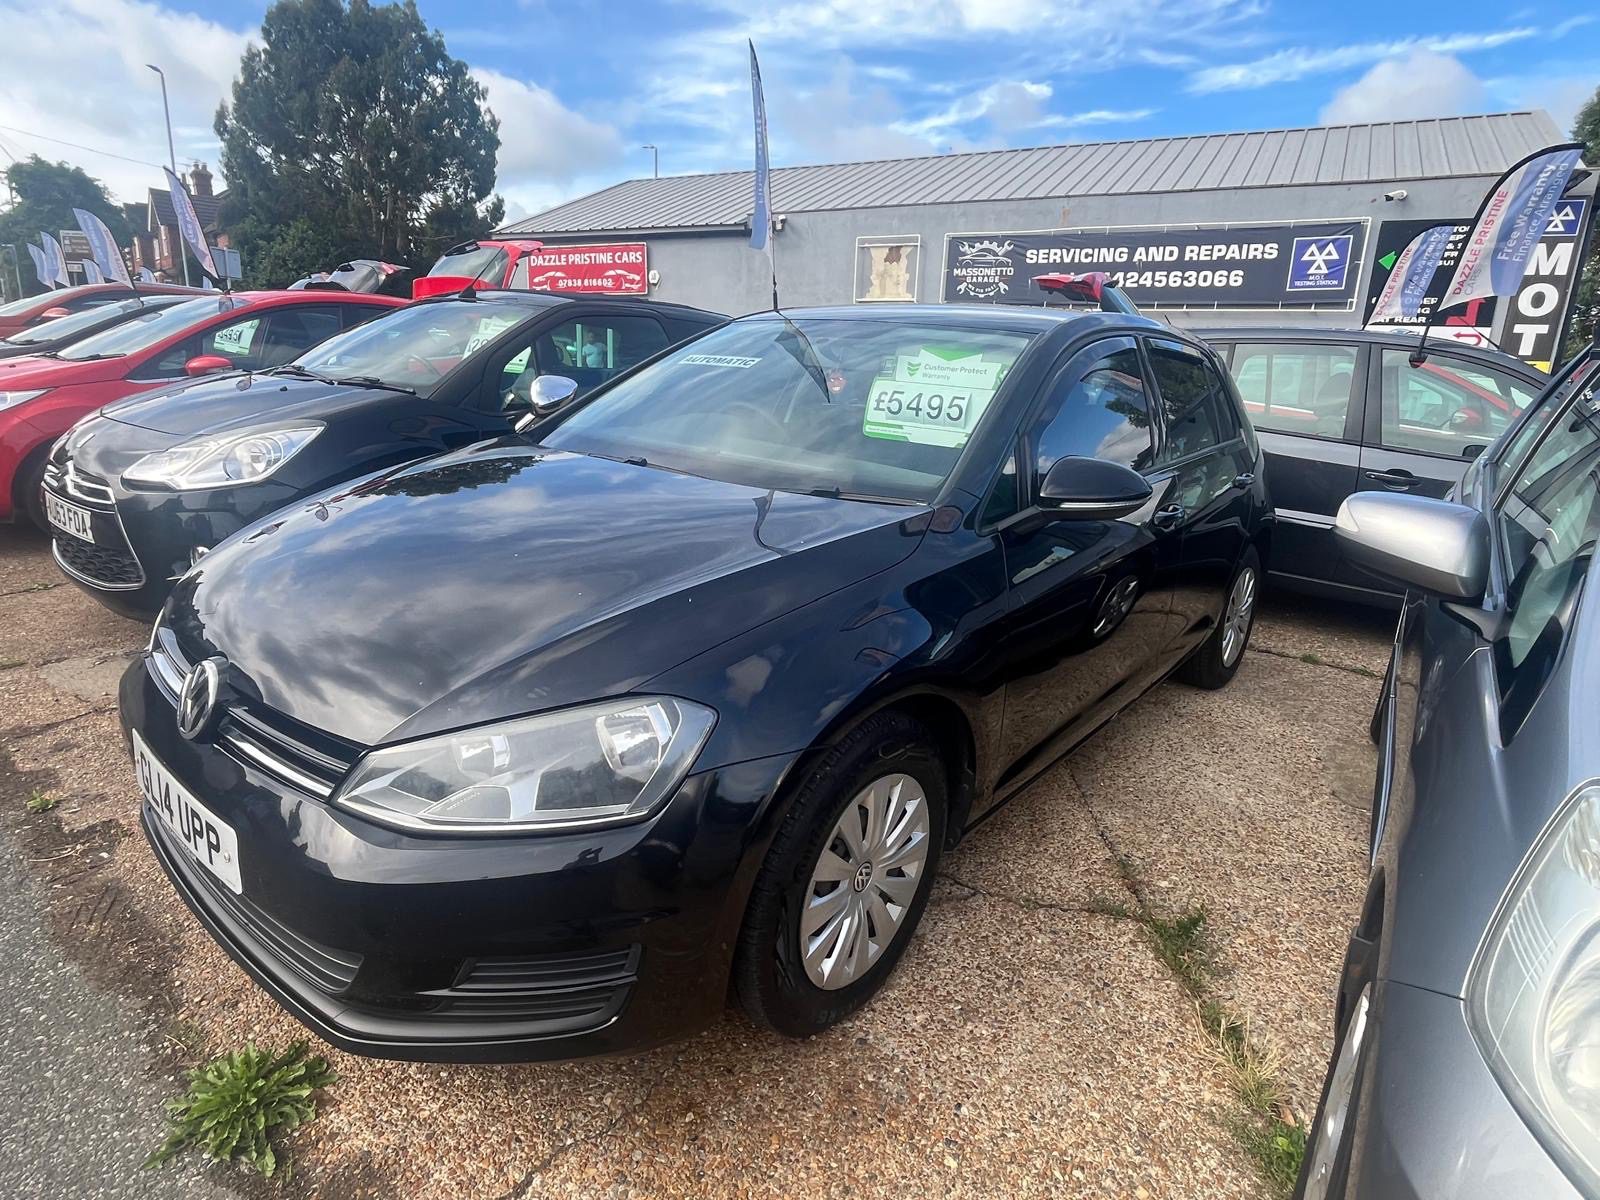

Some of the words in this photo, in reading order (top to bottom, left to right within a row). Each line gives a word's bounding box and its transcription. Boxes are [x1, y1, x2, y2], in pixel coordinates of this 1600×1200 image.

[1497, 230, 1520, 260] Free
[1516, 163, 1557, 231] Warranty
[1512, 219, 1541, 262] Finance
[1537, 163, 1569, 218] Arranged
[1453, 249, 1481, 295] DAZZLE
[1475, 190, 1508, 246] PRISTINE
[530, 254, 567, 267] DAZZLE
[568, 252, 613, 265] PRISTINE
[614, 251, 643, 263] CARS
[1025, 248, 1129, 264] SERVICING
[1133, 246, 1179, 262] AND
[1184, 243, 1279, 261] REPAIRS
[953, 267, 1014, 276] MASSONETTO
[1104, 270, 1245, 288] 424563066
[1376, 285, 1394, 316] DAZZLE
[1391, 247, 1413, 283] PRISTINE
[686, 356, 756, 366] AUTOMATIC
[924, 363, 959, 373] Customer
[960, 366, 988, 375] Protect
[922, 372, 950, 380] Warranty
[873, 390, 966, 422] £5495
[177, 794, 221, 866] UPP
